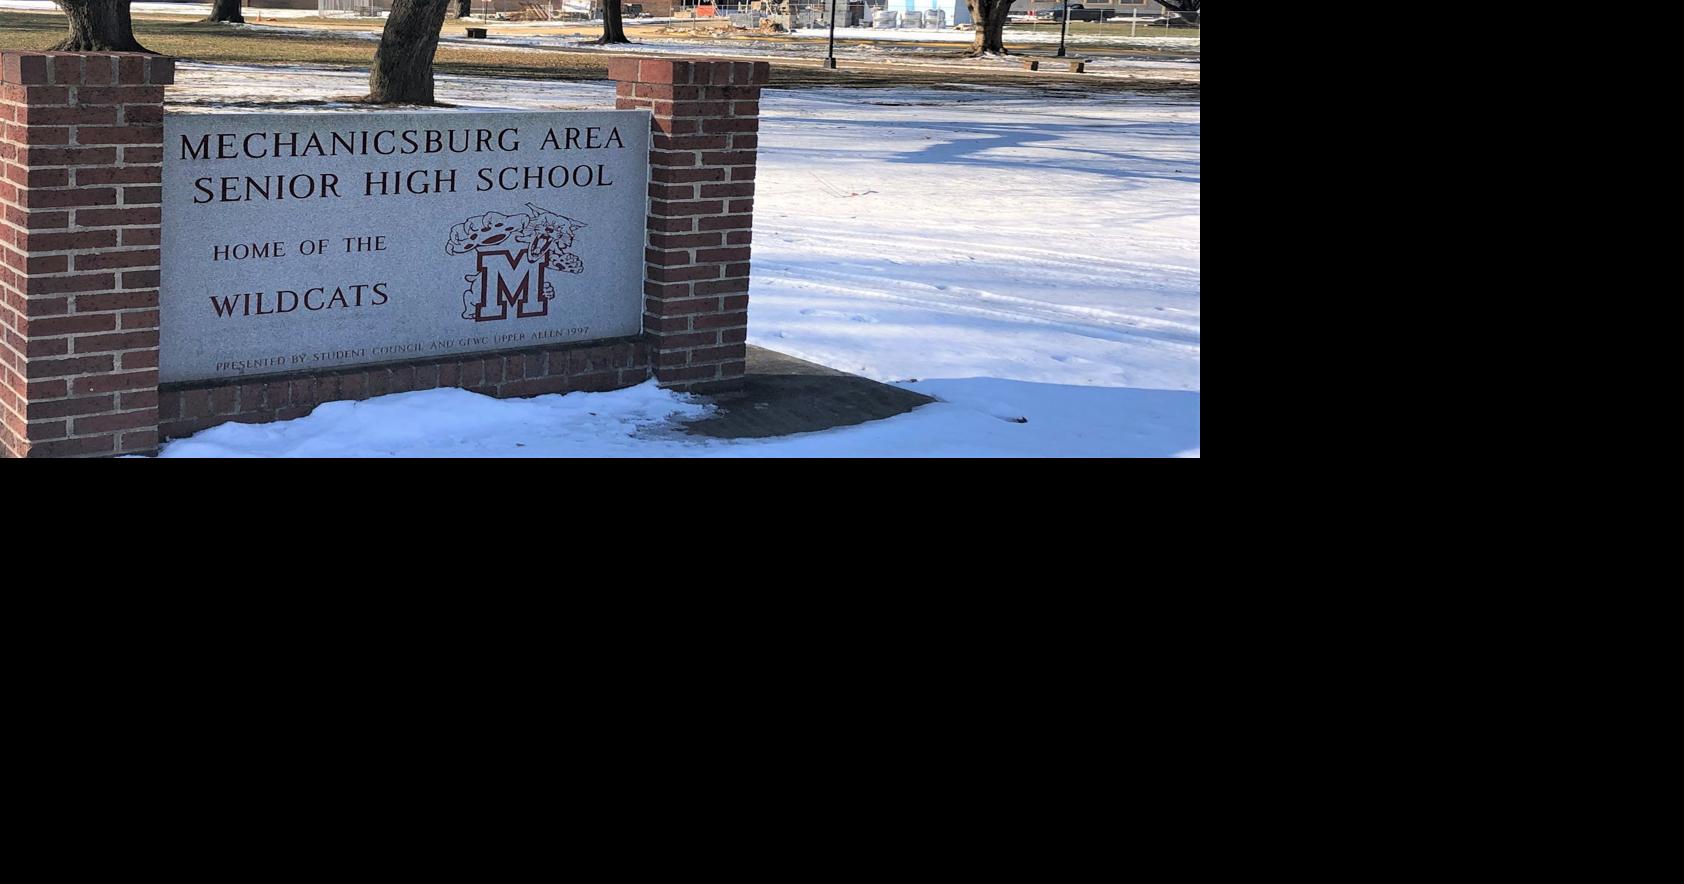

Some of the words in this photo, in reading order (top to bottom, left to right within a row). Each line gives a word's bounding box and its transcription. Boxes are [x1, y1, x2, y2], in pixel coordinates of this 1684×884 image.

[180, 127, 521, 160] MECHANICSBURG
[540, 126, 625, 151] AREA
[193, 173, 342, 204] SENIOR
[363, 169, 458, 196] HIGH
[476, 164, 614, 192] SCHOOL
[213, 241, 286, 262] HOME
[299, 238, 330, 256] OF
[342, 235, 388, 253] THE
[208, 282, 389, 319] WILDCATS
[475, 249, 550, 323] M
[215, 356, 287, 372] PRESENTED
[291, 352, 307, 364] BY
[313, 348, 367, 361] STUDENT
[372, 342, 424, 356] COUNCIL
[430, 338, 455, 350] AND
[494, 332, 526, 345] UPPER
[531, 328, 563, 340] ALLEN
[567, 325, 590, 337] 1997
